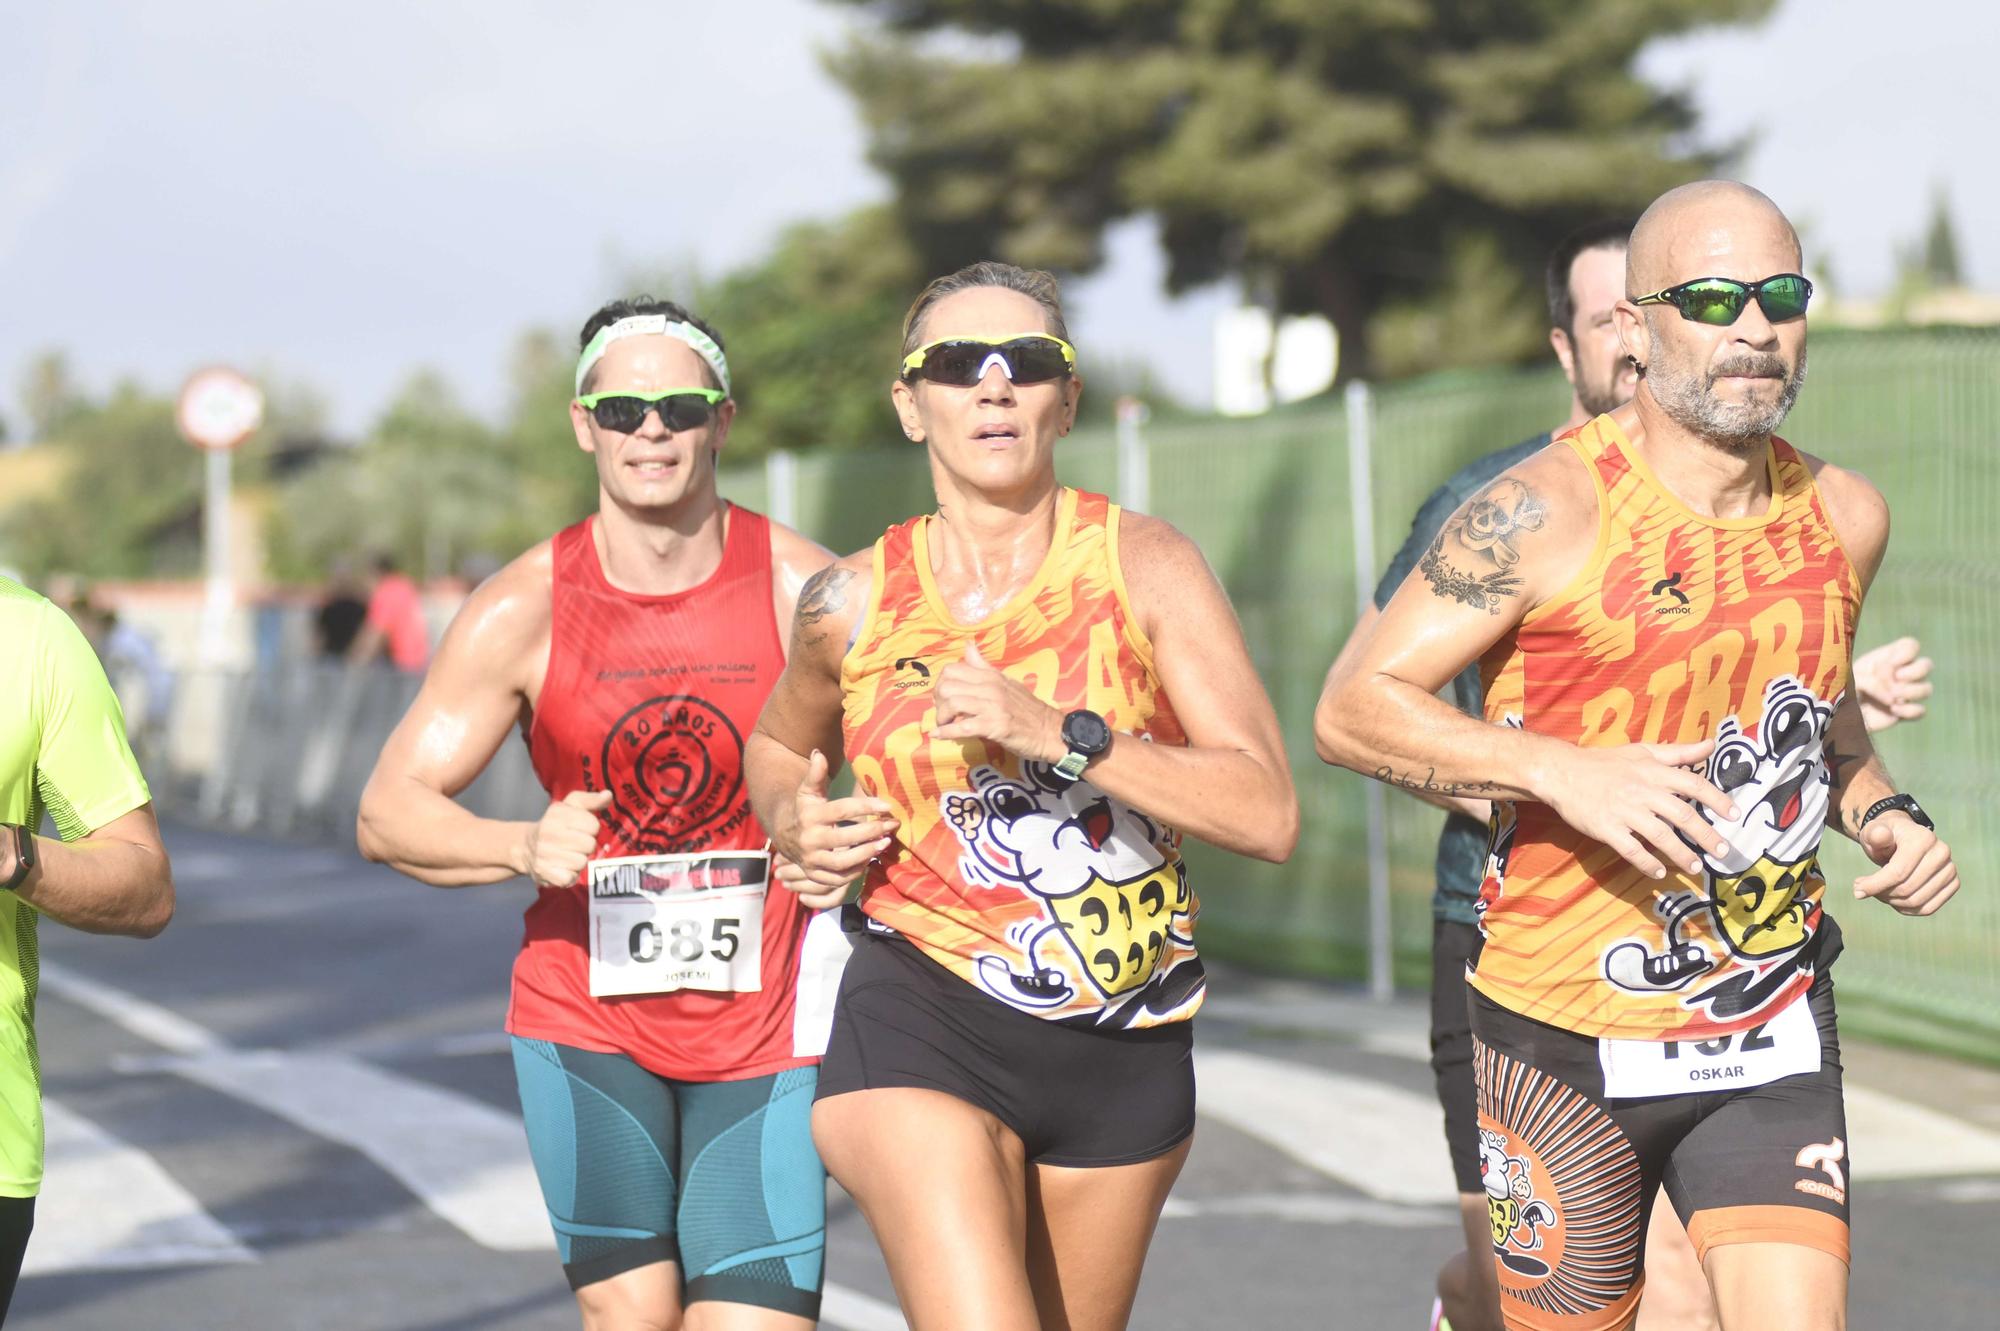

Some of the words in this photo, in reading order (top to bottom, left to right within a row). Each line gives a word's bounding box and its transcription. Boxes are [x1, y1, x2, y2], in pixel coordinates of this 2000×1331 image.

[624, 719, 651, 747] 20
[629, 918, 740, 963] 085
[1689, 1065, 1745, 1081] OSKAR
